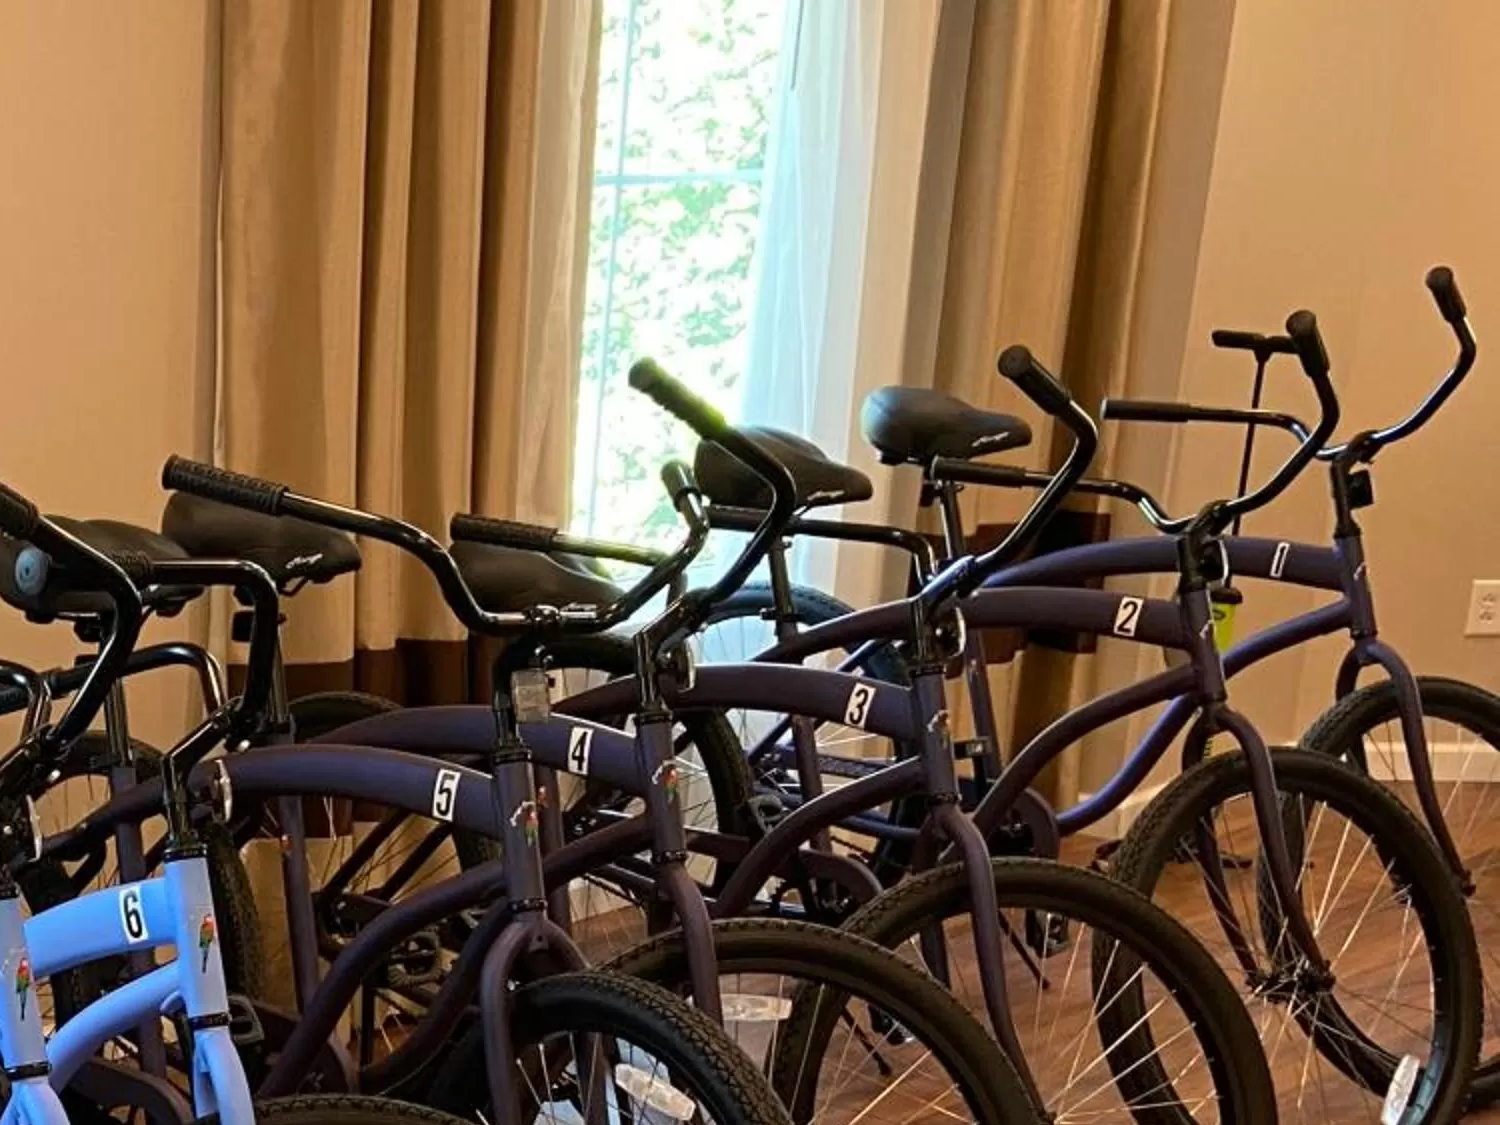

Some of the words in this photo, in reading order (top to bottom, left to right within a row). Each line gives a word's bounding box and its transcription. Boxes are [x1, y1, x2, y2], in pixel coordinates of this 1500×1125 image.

[1118, 601, 1138, 632] 2
[850, 689, 868, 725] 3
[572, 731, 588, 771] 4
[436, 773, 455, 816] 5
[123, 890, 143, 939] 6
